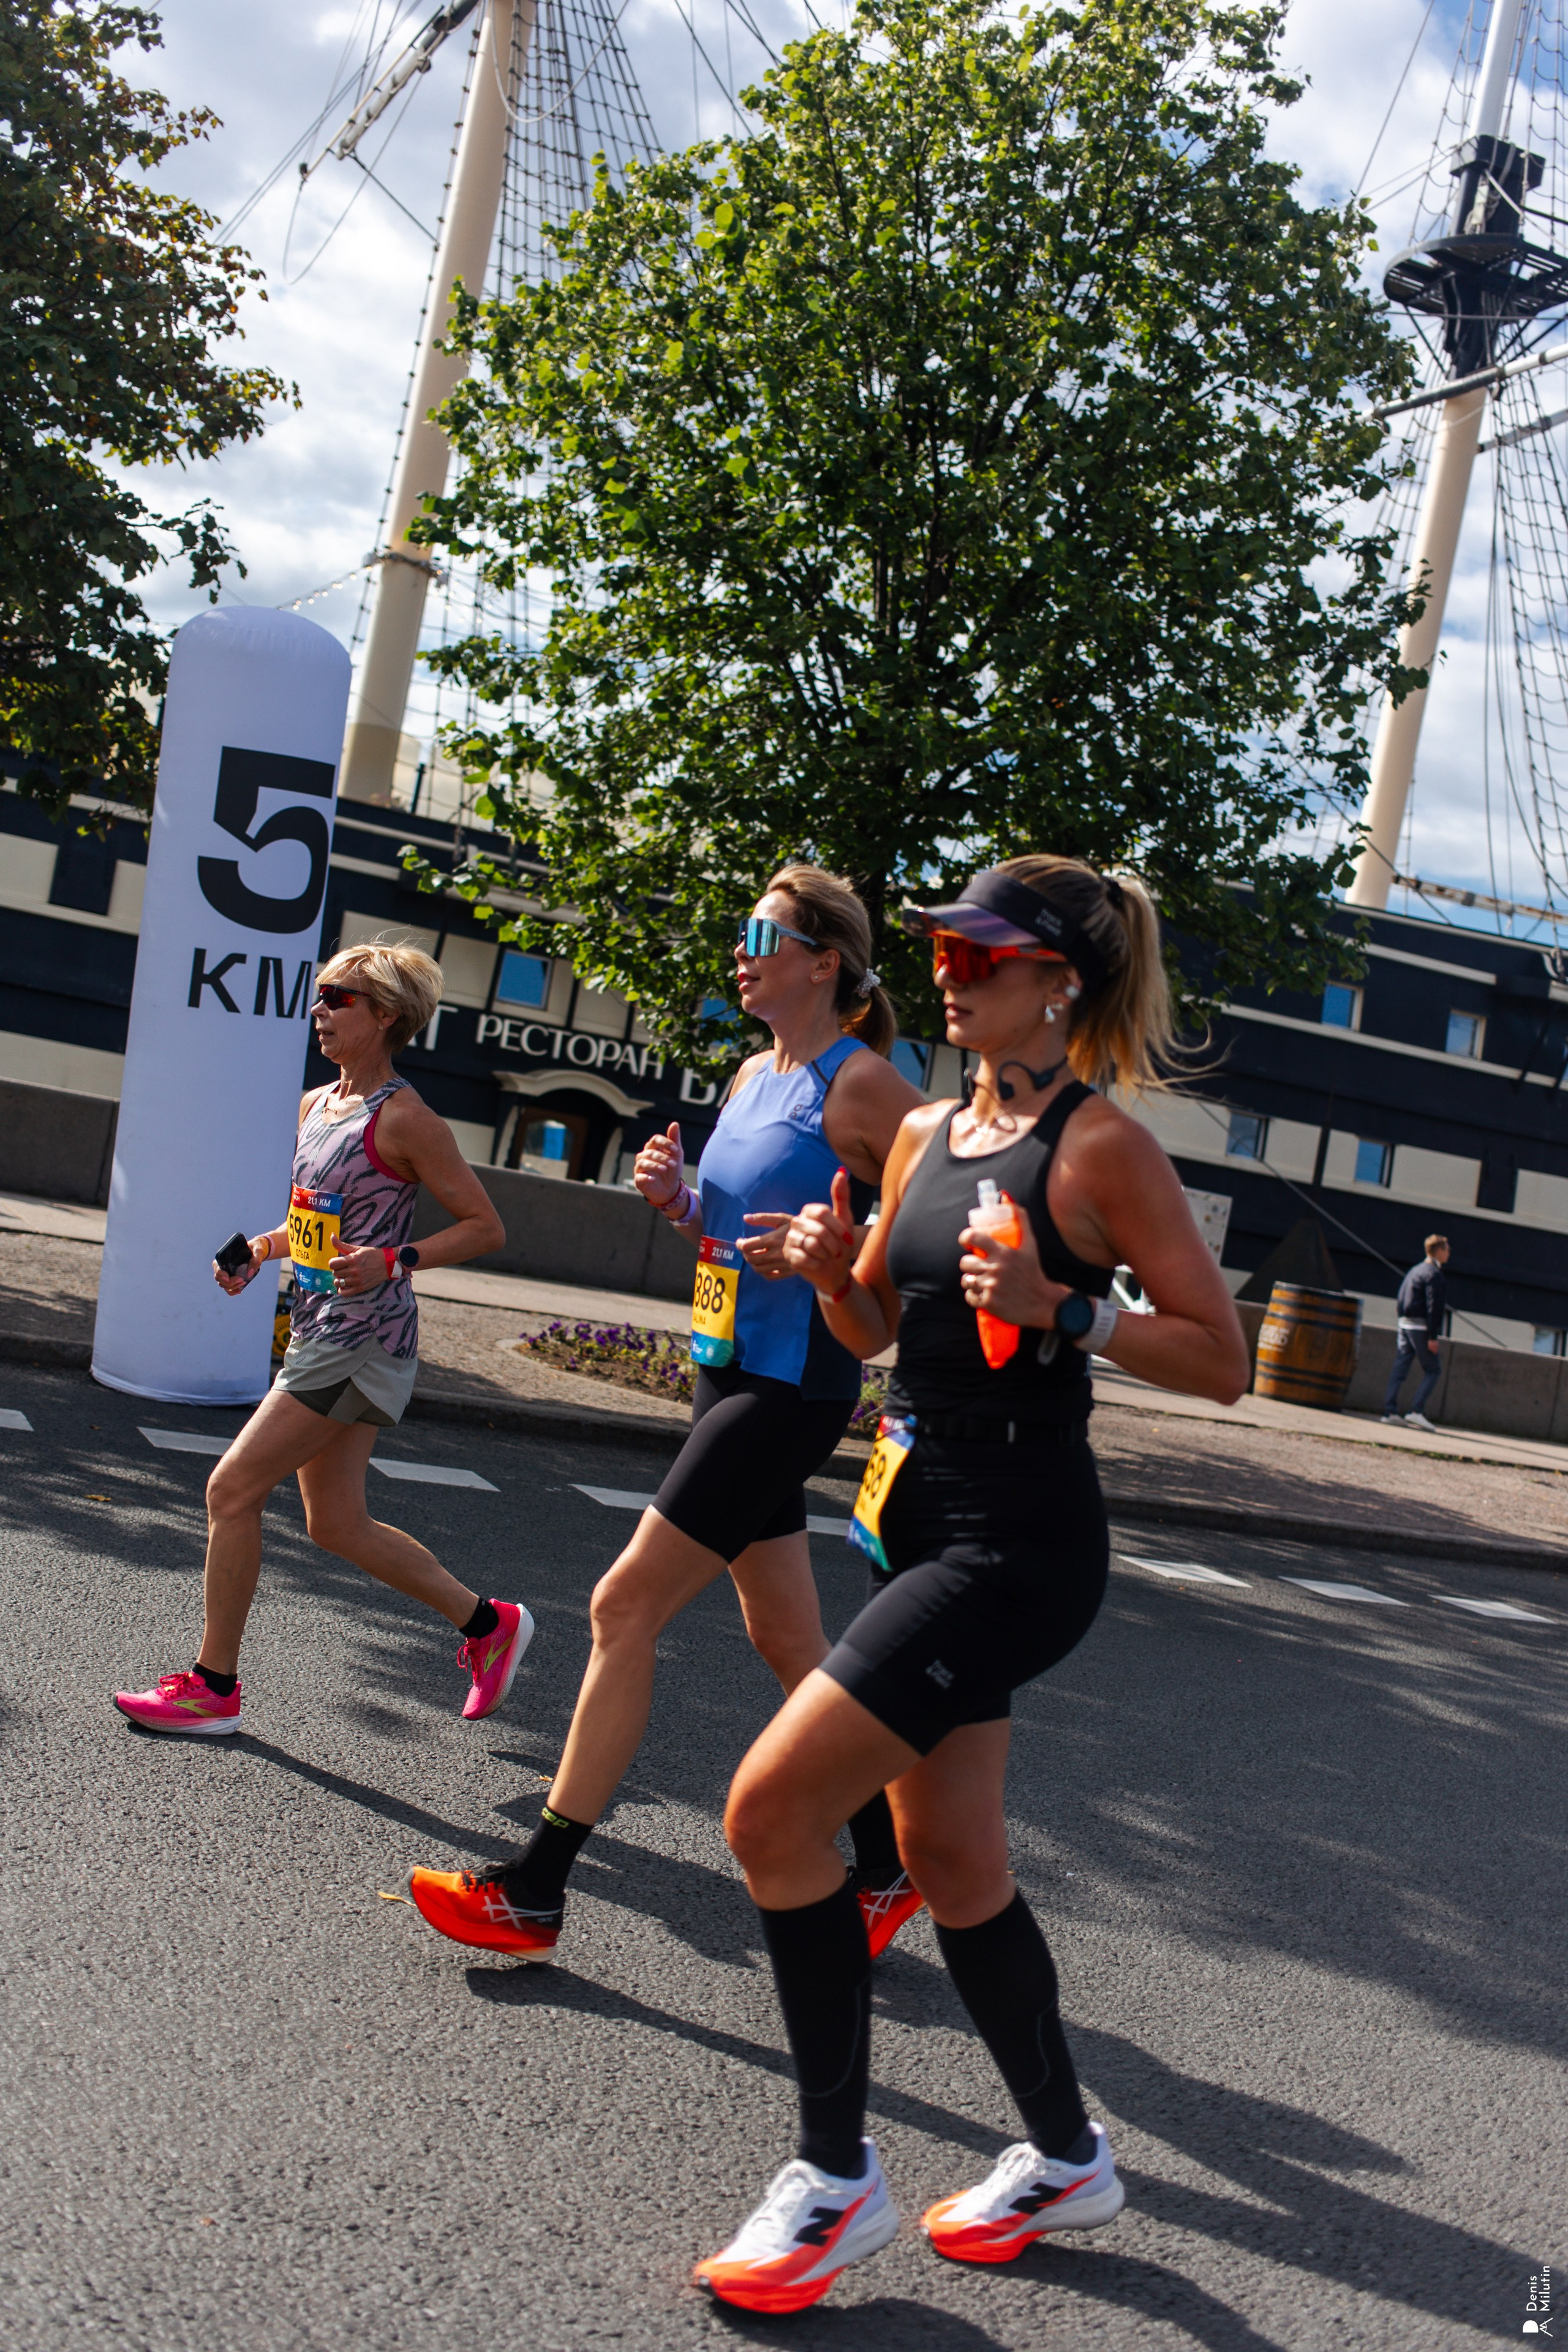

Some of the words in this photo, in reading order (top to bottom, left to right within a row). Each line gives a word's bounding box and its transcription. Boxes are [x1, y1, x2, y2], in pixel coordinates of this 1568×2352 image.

[197, 745, 336, 935] 5
[476, 1013, 664, 1080] РЕСТОРАН
[307, 1196, 318, 1206] 21,1
[290, 1213, 324, 1251] 5961
[296, 1248, 310, 1261] ОЛЬГА
[541, 1807, 570, 1828] cep
